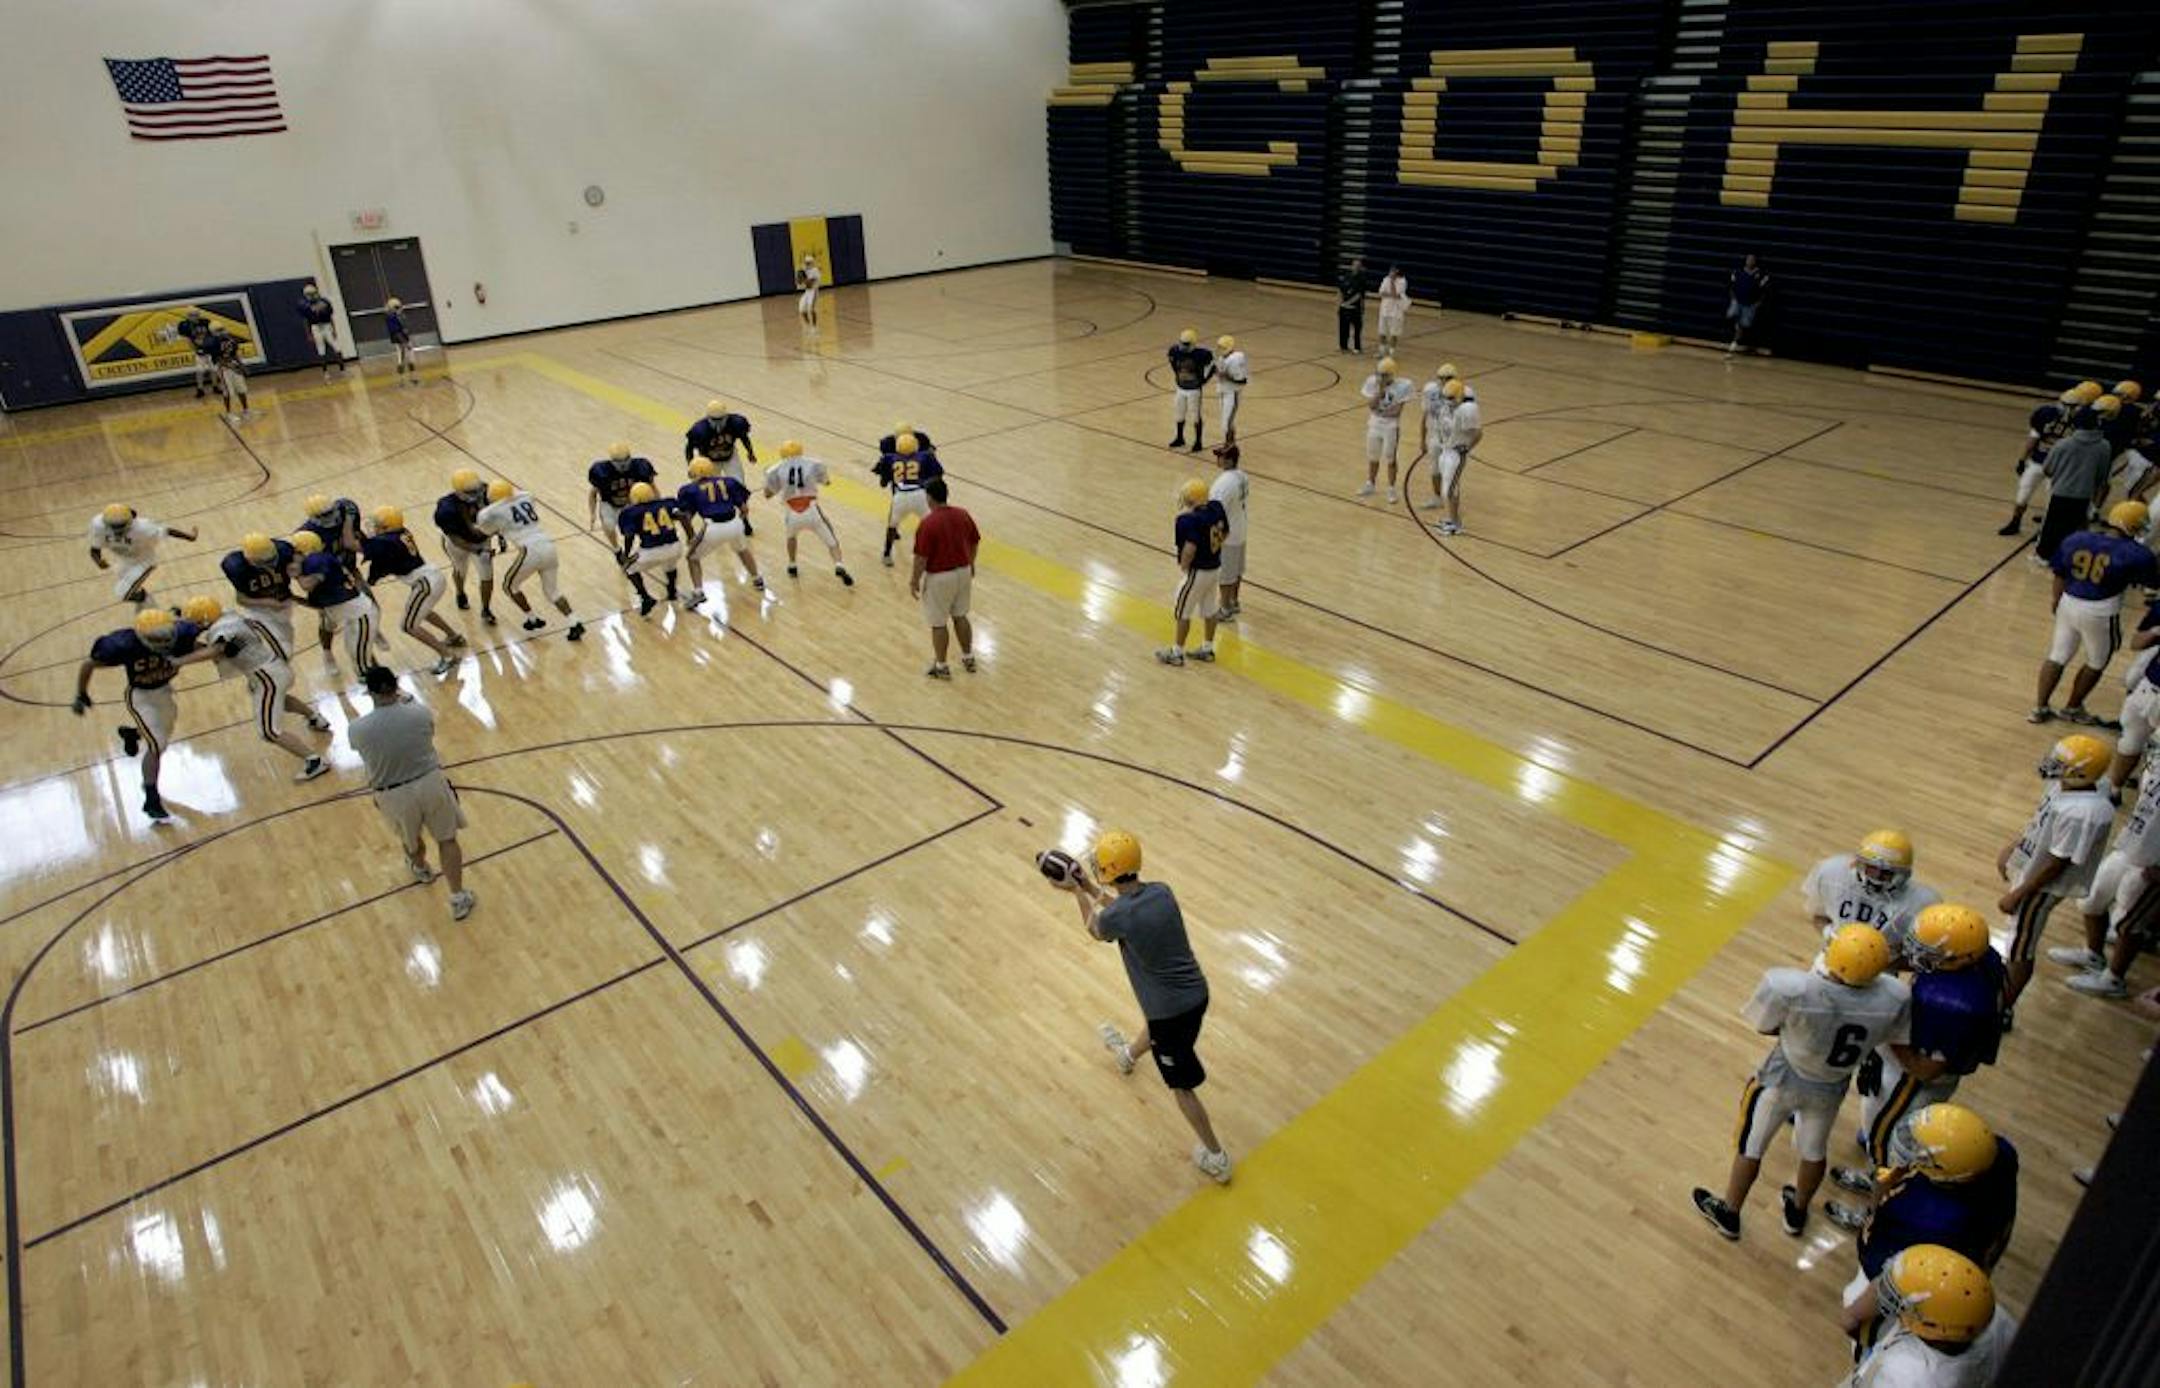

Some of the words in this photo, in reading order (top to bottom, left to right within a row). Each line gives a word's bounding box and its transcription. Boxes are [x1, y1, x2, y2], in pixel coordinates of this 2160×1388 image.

[788, 466, 804, 488] 41
[892, 460, 920, 483] 22
[701, 480, 729, 503] 71
[511, 501, 539, 525] 48
[642, 507, 674, 535] 44
[2071, 550, 2110, 584] 96
[1827, 1024, 1868, 1067] 6
